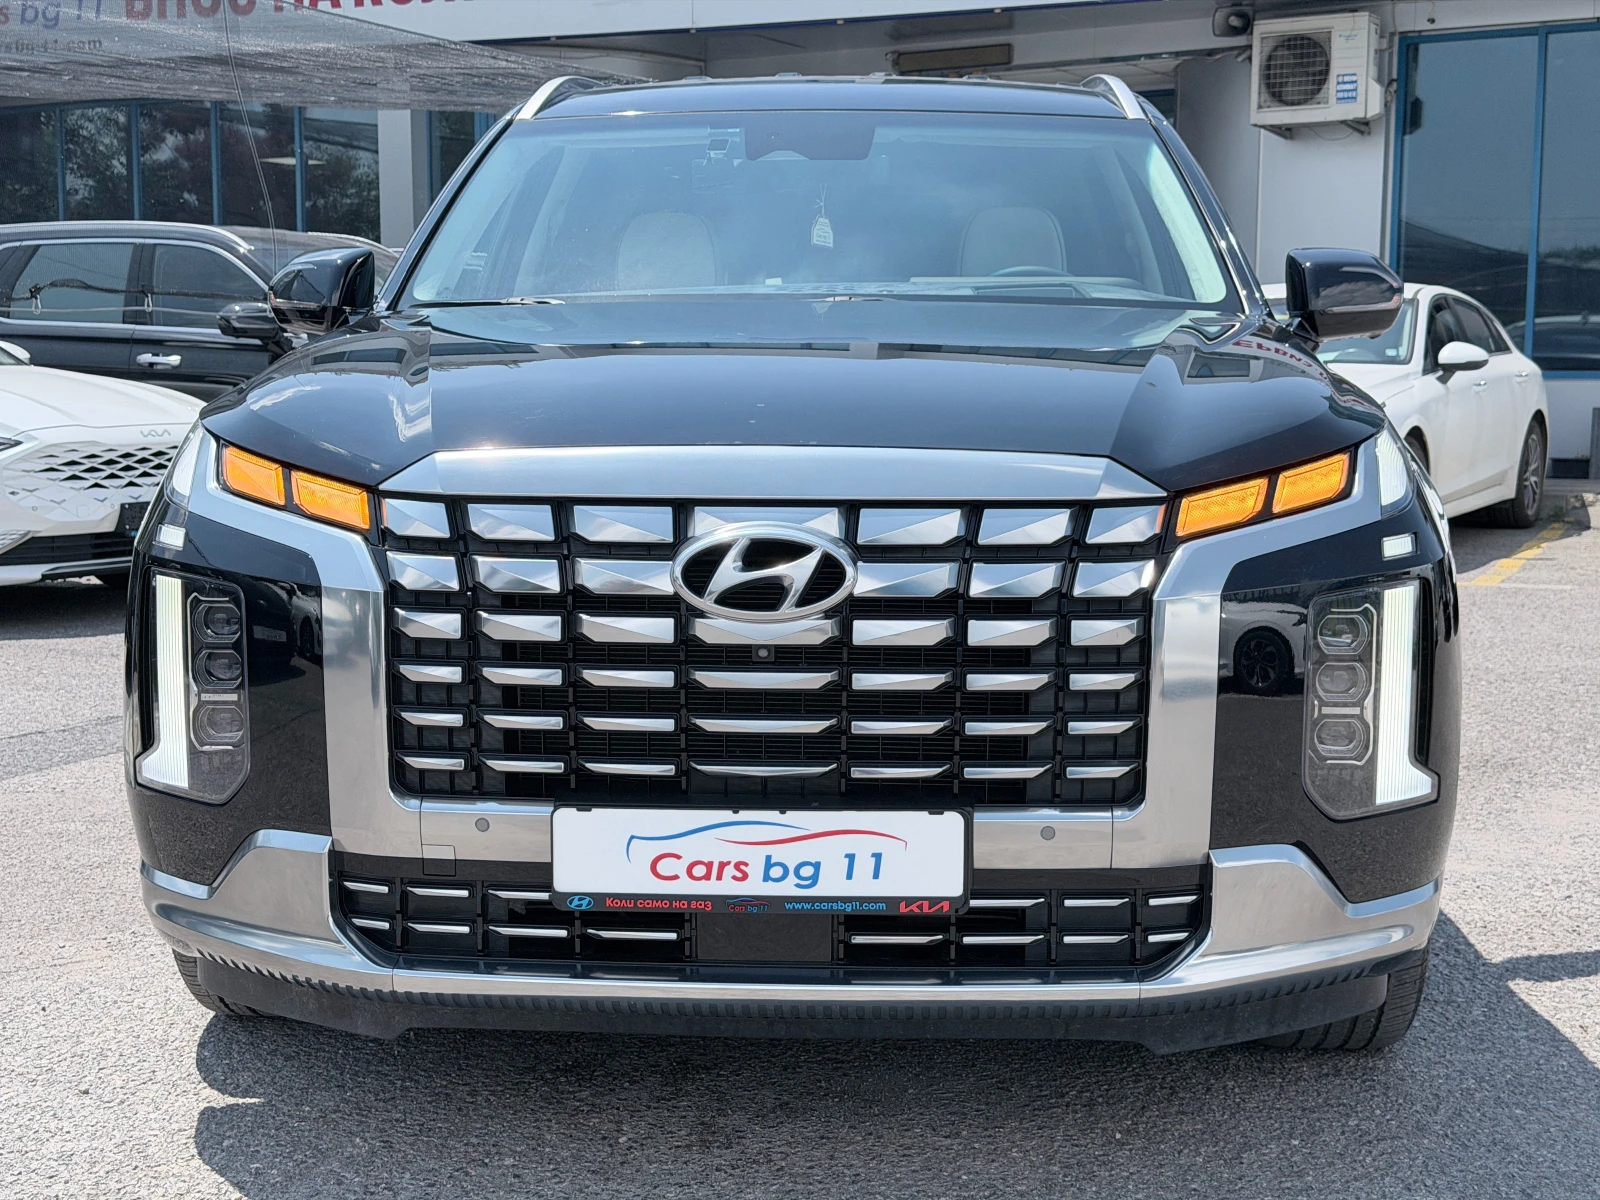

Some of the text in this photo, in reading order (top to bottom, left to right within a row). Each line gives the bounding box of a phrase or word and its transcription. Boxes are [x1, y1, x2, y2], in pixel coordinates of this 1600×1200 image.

[649, 852, 883, 890] Cars bg 11
[605, 897, 635, 908] Коли
[636, 899, 670, 908] само
[672, 900, 688, 909] на
[784, 901, 886, 912] www.carsbg11.com
[747, 905, 758, 914] bg
